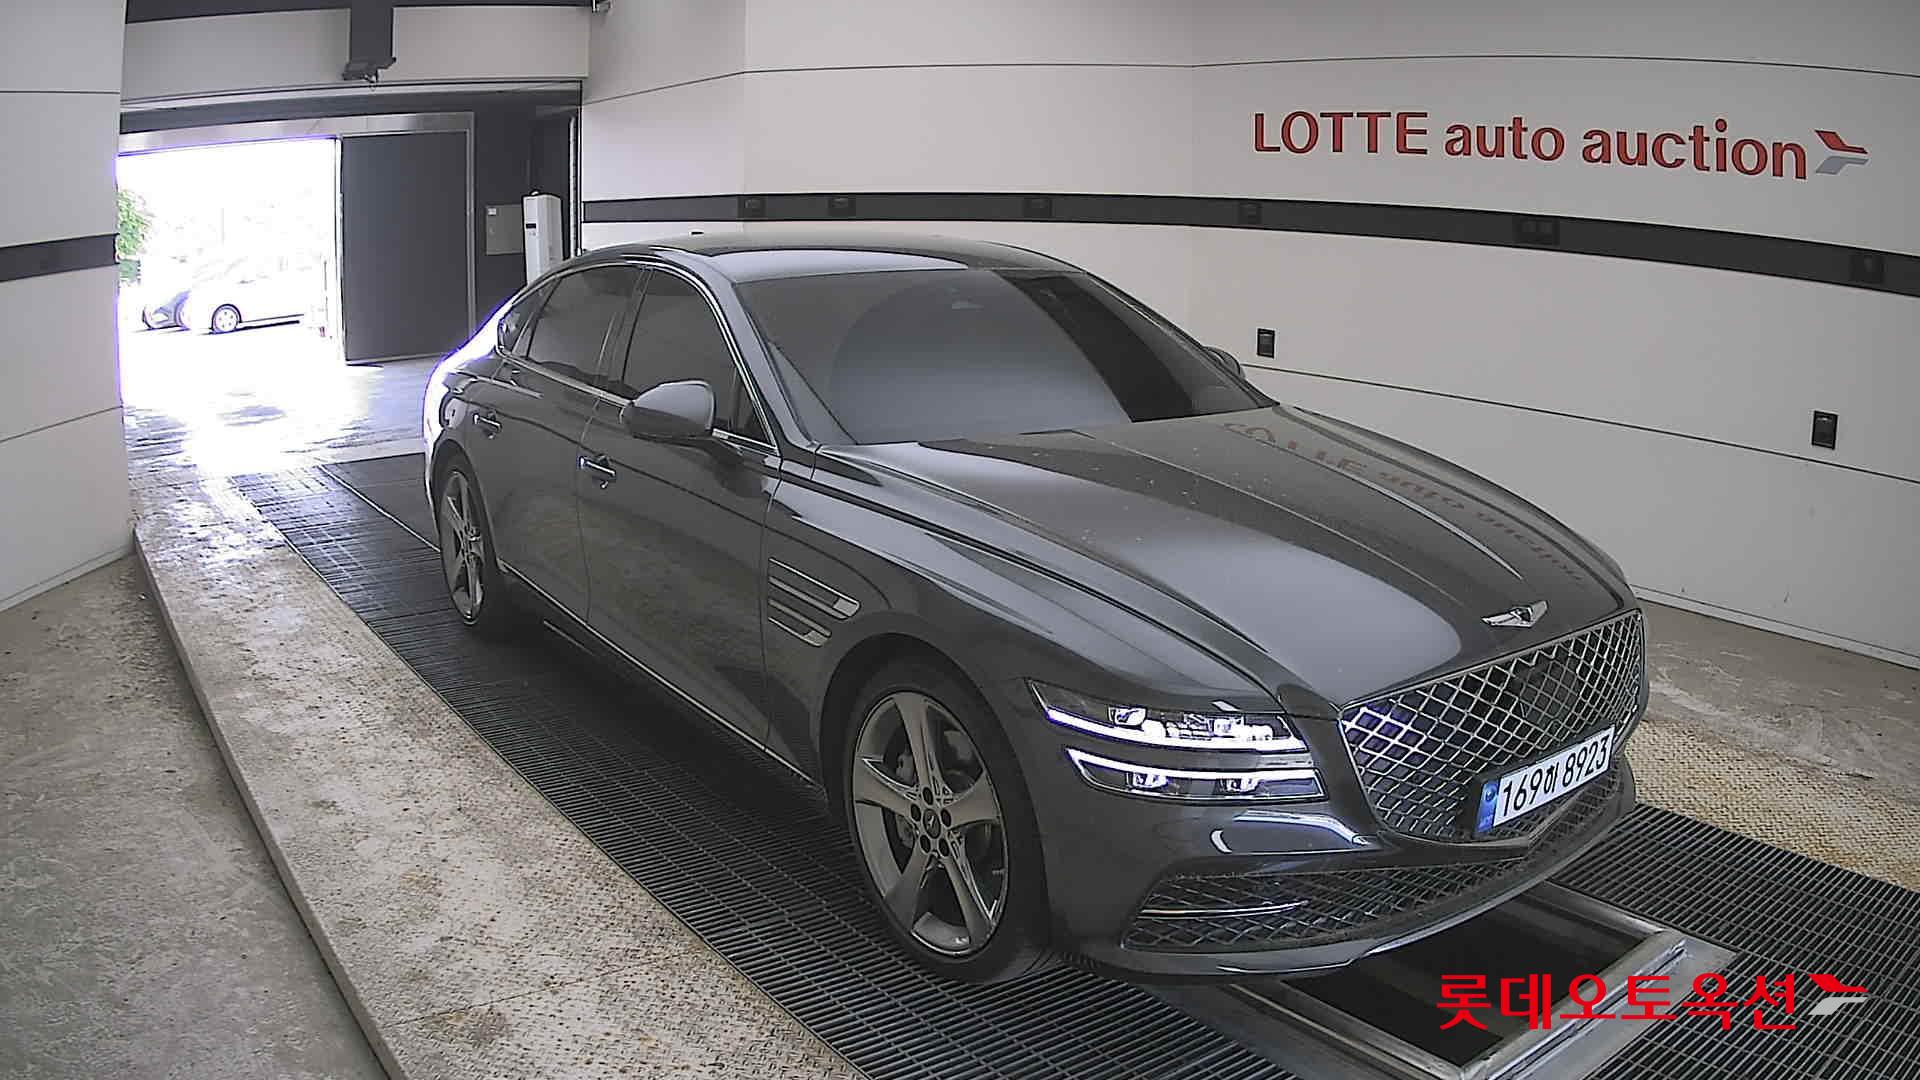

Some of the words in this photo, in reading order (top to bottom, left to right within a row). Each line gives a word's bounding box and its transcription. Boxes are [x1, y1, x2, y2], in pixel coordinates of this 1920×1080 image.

[1253, 111, 1428, 155] LOTTE
[1445, 116, 1566, 161] auto
[1582, 119, 1807, 179] auction
[1562, 734, 1610, 788] 8923
